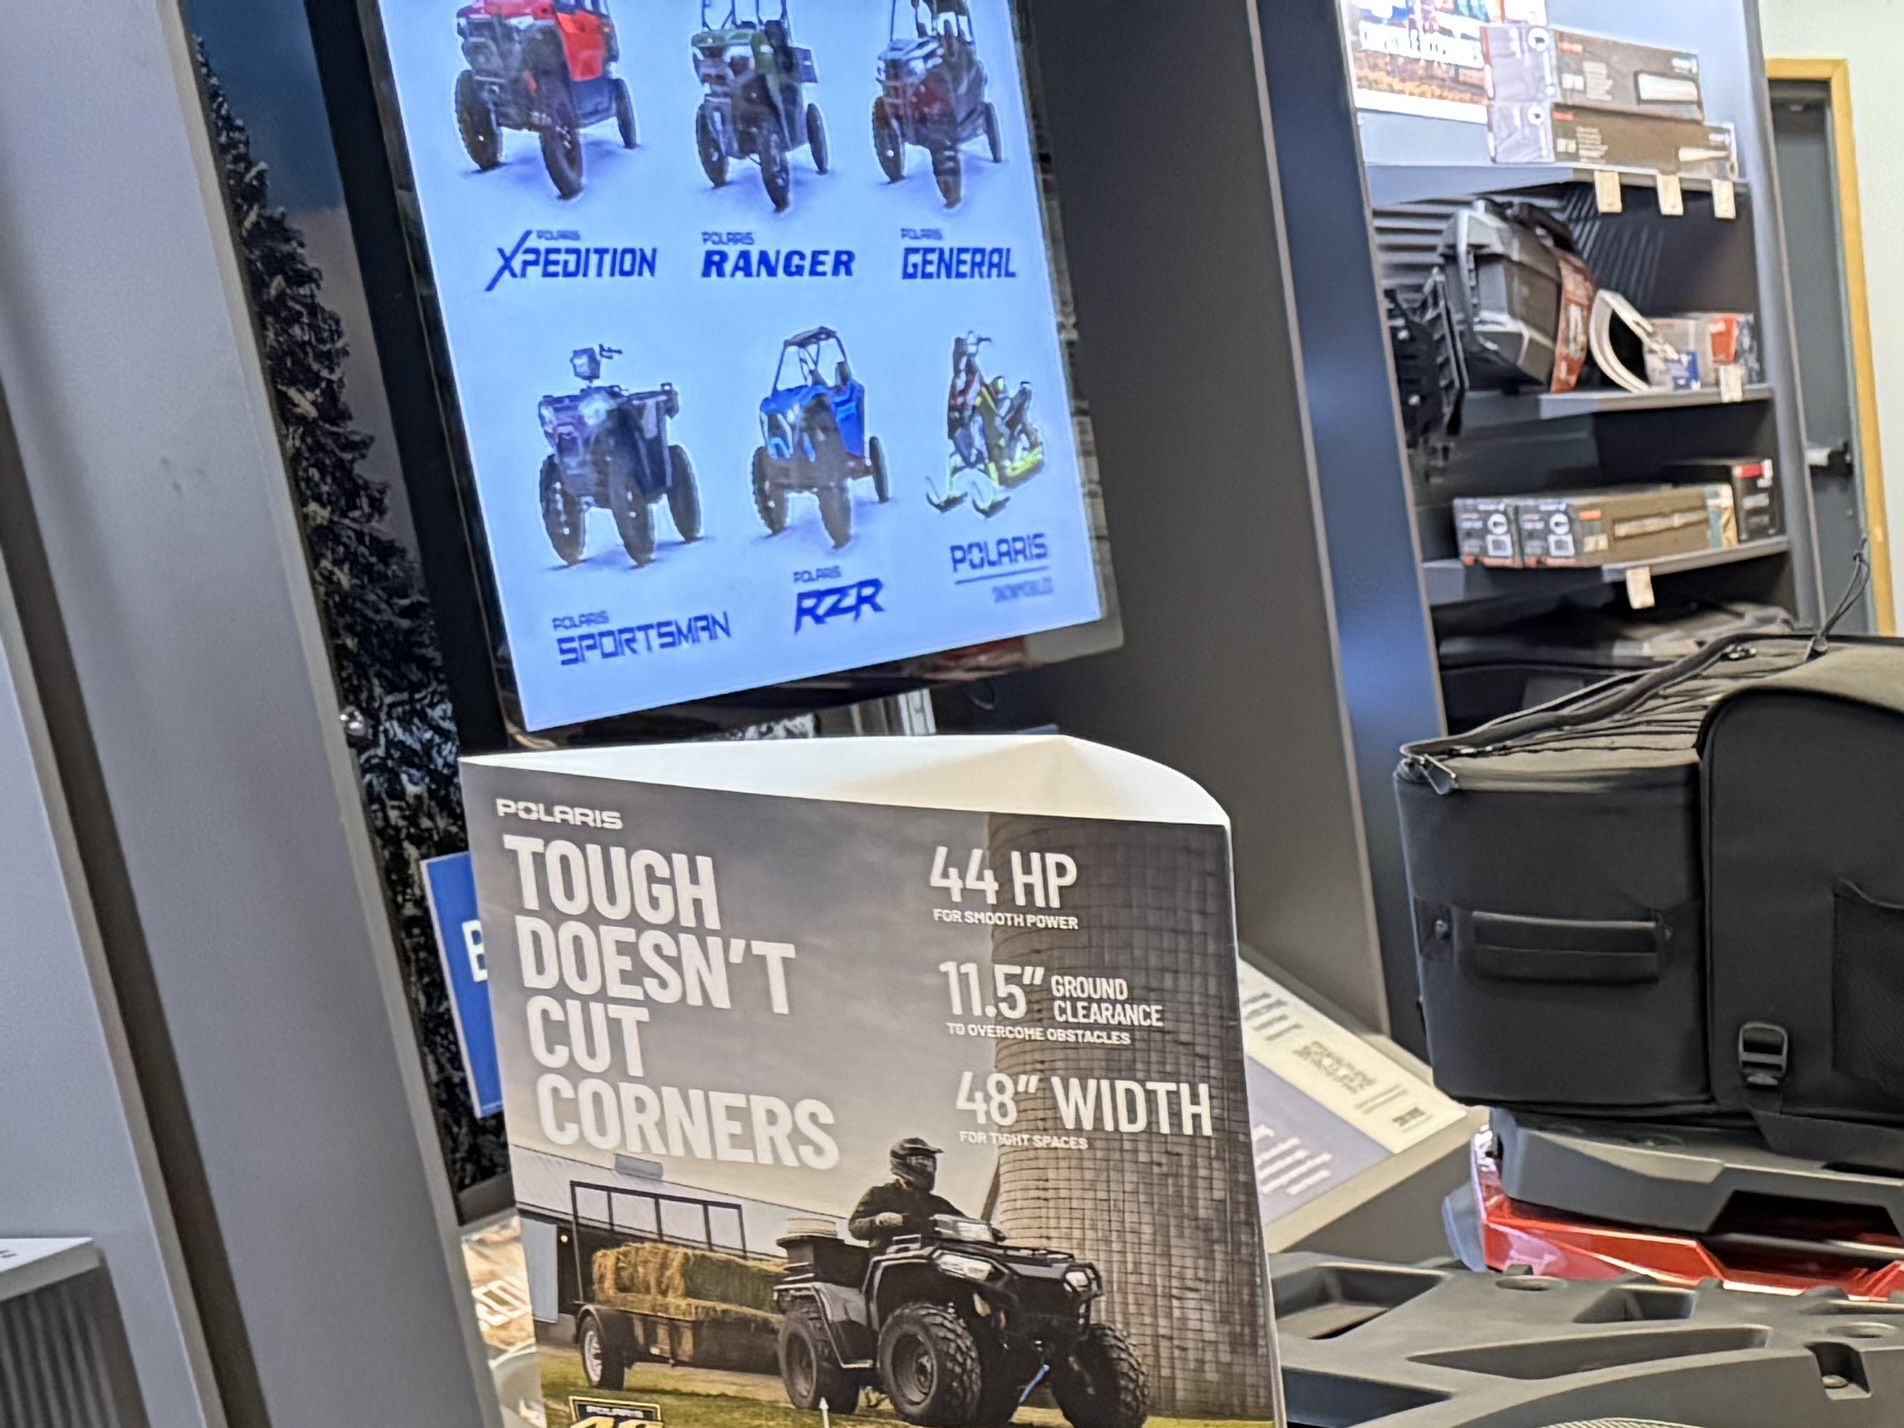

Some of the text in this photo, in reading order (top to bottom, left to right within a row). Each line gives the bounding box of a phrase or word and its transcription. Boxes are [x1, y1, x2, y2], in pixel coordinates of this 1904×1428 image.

[701, 232, 755, 246] POLARIS
[485, 230, 658, 292] XPEDITION
[701, 249, 856, 279] RANGER
[901, 247, 1016, 280] GENERAL
[950, 533, 1048, 573] POLARIS
[793, 566, 843, 583] POLARIS
[552, 610, 609, 631] POLARIS
[795, 578, 885, 635] RZR
[557, 611, 732, 666] SPORTSMAN
[496, 798, 623, 830] POLARIS
[502, 833, 722, 931] TOUGH
[929, 846, 1078, 909] 44 HP
[933, 908, 1079, 930] FOR SMOOTH POWER
[514, 914, 797, 1015] DOESN'T
[938, 960, 1128, 1020] 11.5" GROUND
[946, 1022, 1132, 1045] TO OVERCOME OBSTACLES
[1053, 1001, 1164, 1027] CLEARANCE
[526, 994, 650, 1078] CUT
[535, 1072, 840, 1171] CORNERS
[955, 1070, 1213, 1137] 48" WIDTH
[959, 1130, 1089, 1150] FOR TIGHT SPACES
